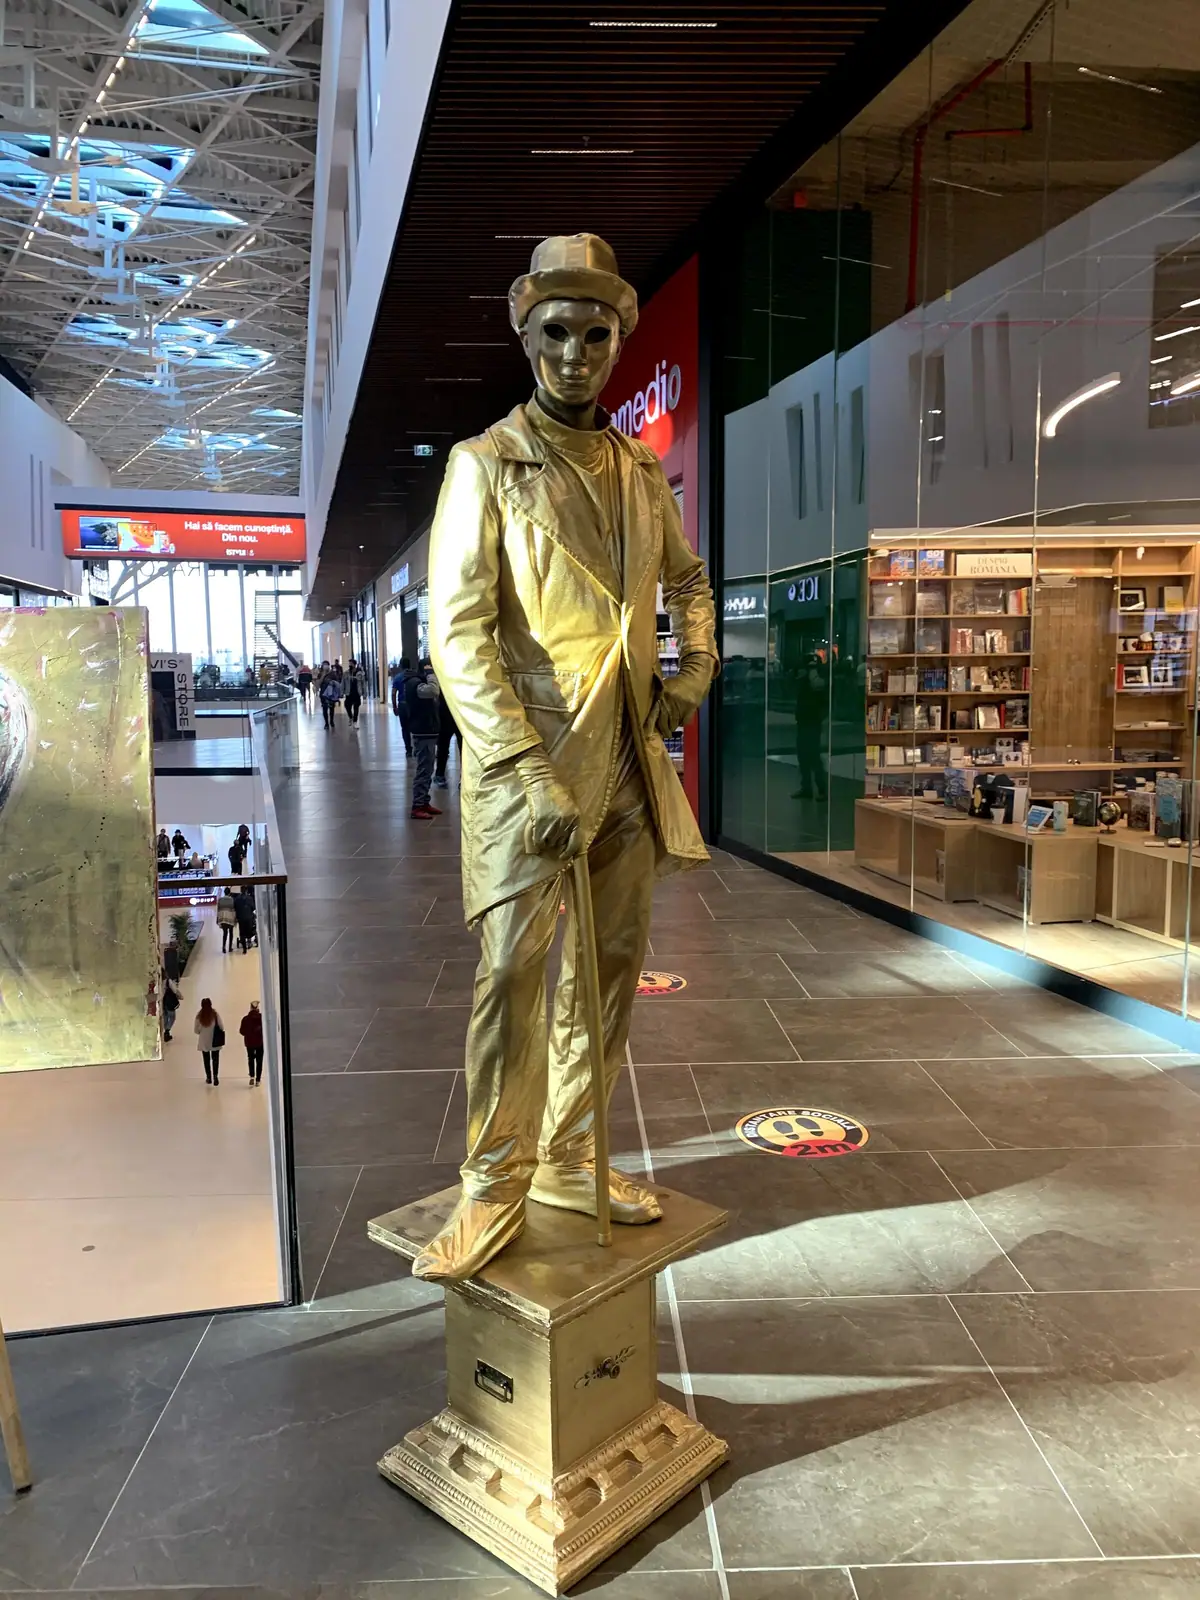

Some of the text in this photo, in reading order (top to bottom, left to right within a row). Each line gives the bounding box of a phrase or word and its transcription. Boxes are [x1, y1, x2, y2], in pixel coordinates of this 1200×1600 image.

[184, 521, 201, 530] Hai
[202, 521, 213, 531] să
[214, 522, 243, 532] facem
[221, 533, 259, 543] Din nou.
[176, 673, 189, 727] STORE
[790, 1143, 852, 1156] 2m
